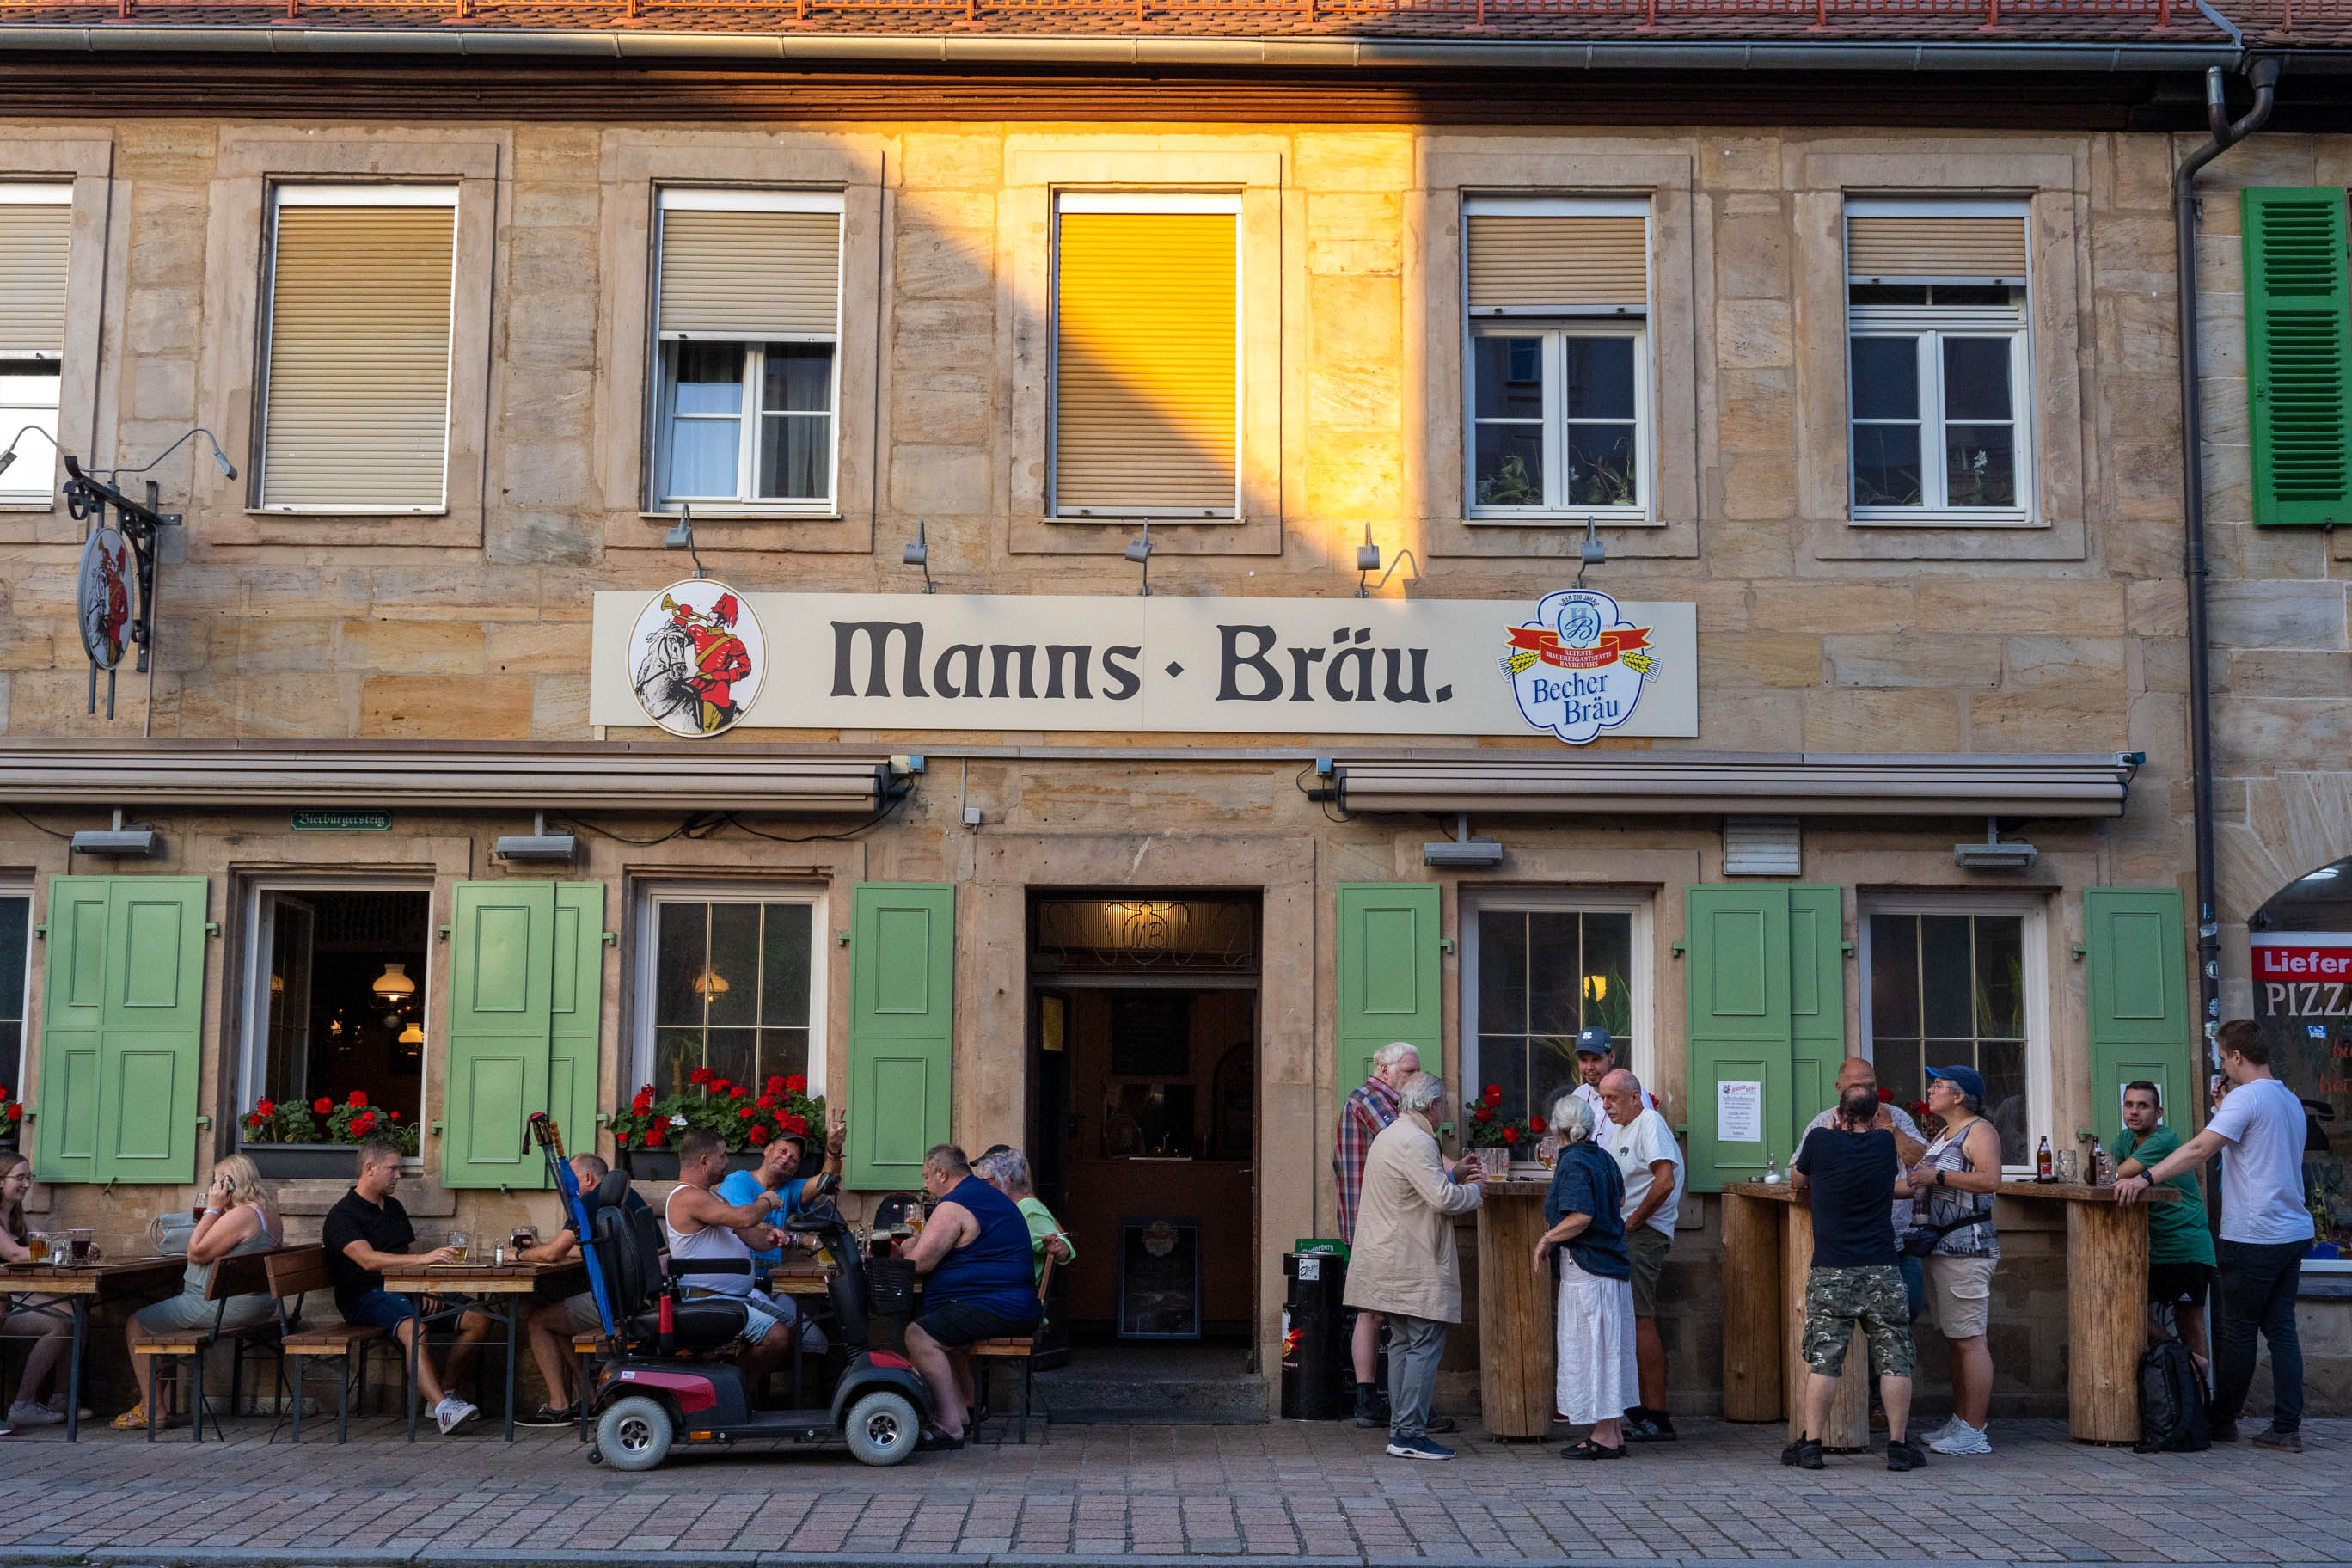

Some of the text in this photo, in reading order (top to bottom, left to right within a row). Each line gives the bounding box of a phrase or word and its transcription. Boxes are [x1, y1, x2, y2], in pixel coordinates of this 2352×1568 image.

[1583, 595, 1600, 606] JAHRE
[830, 621, 1453, 703] Manns Bräu.
[1533, 672, 1608, 704] Becher
[1563, 696, 1620, 726] Bräu
[2264, 950, 2352, 973] Liefer
[2264, 983, 2352, 1016] PIZZ
